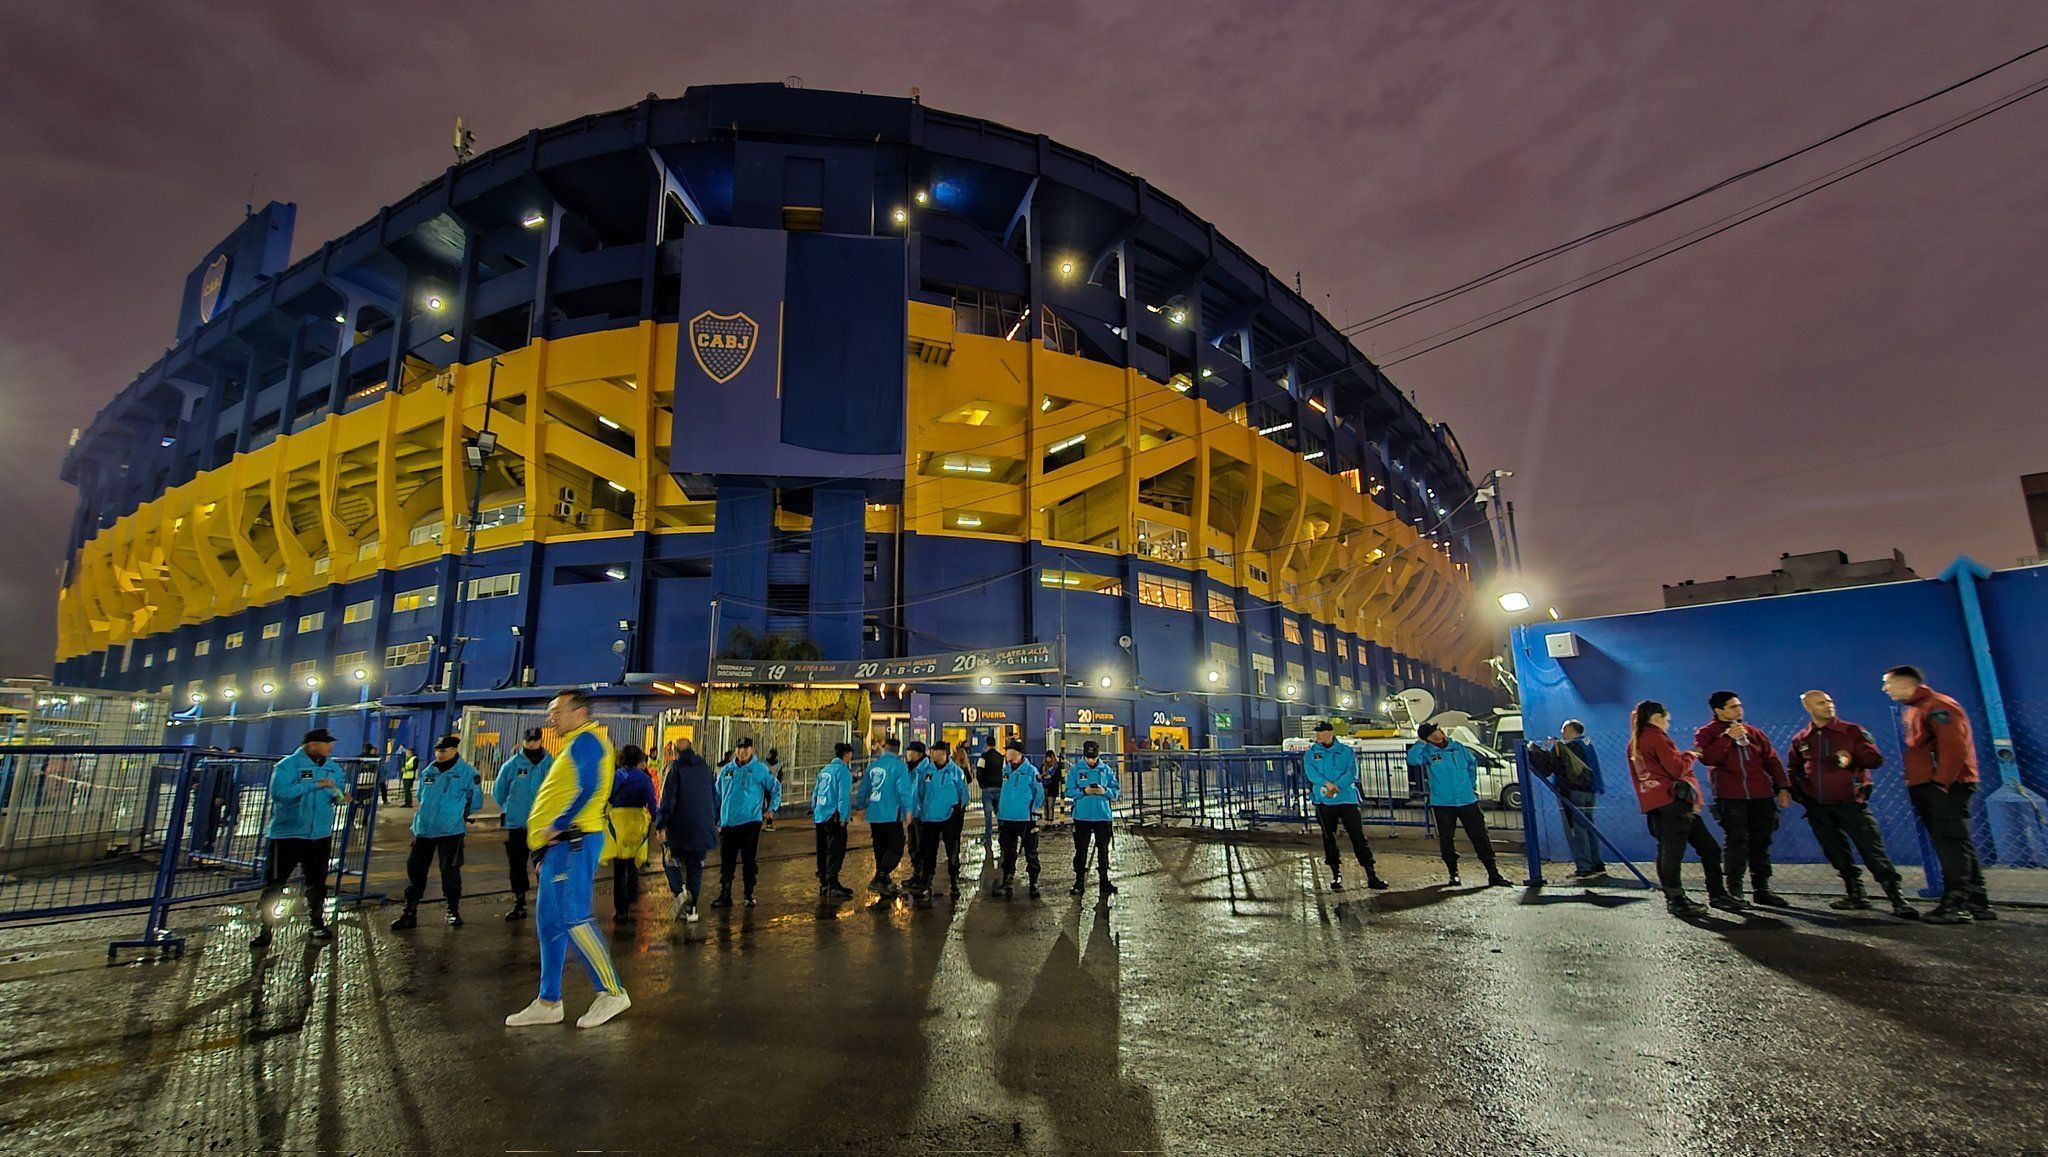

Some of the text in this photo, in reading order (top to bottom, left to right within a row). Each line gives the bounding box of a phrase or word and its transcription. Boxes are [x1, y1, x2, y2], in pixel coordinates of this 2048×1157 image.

[697, 333, 750, 349] CABJ
[767, 665, 787, 680] 19
[854, 662, 879, 678] 20
[960, 707, 1007, 722] 19 PUERTA
[1077, 709, 1092, 722] 20
[1153, 712, 1165, 725] 20
